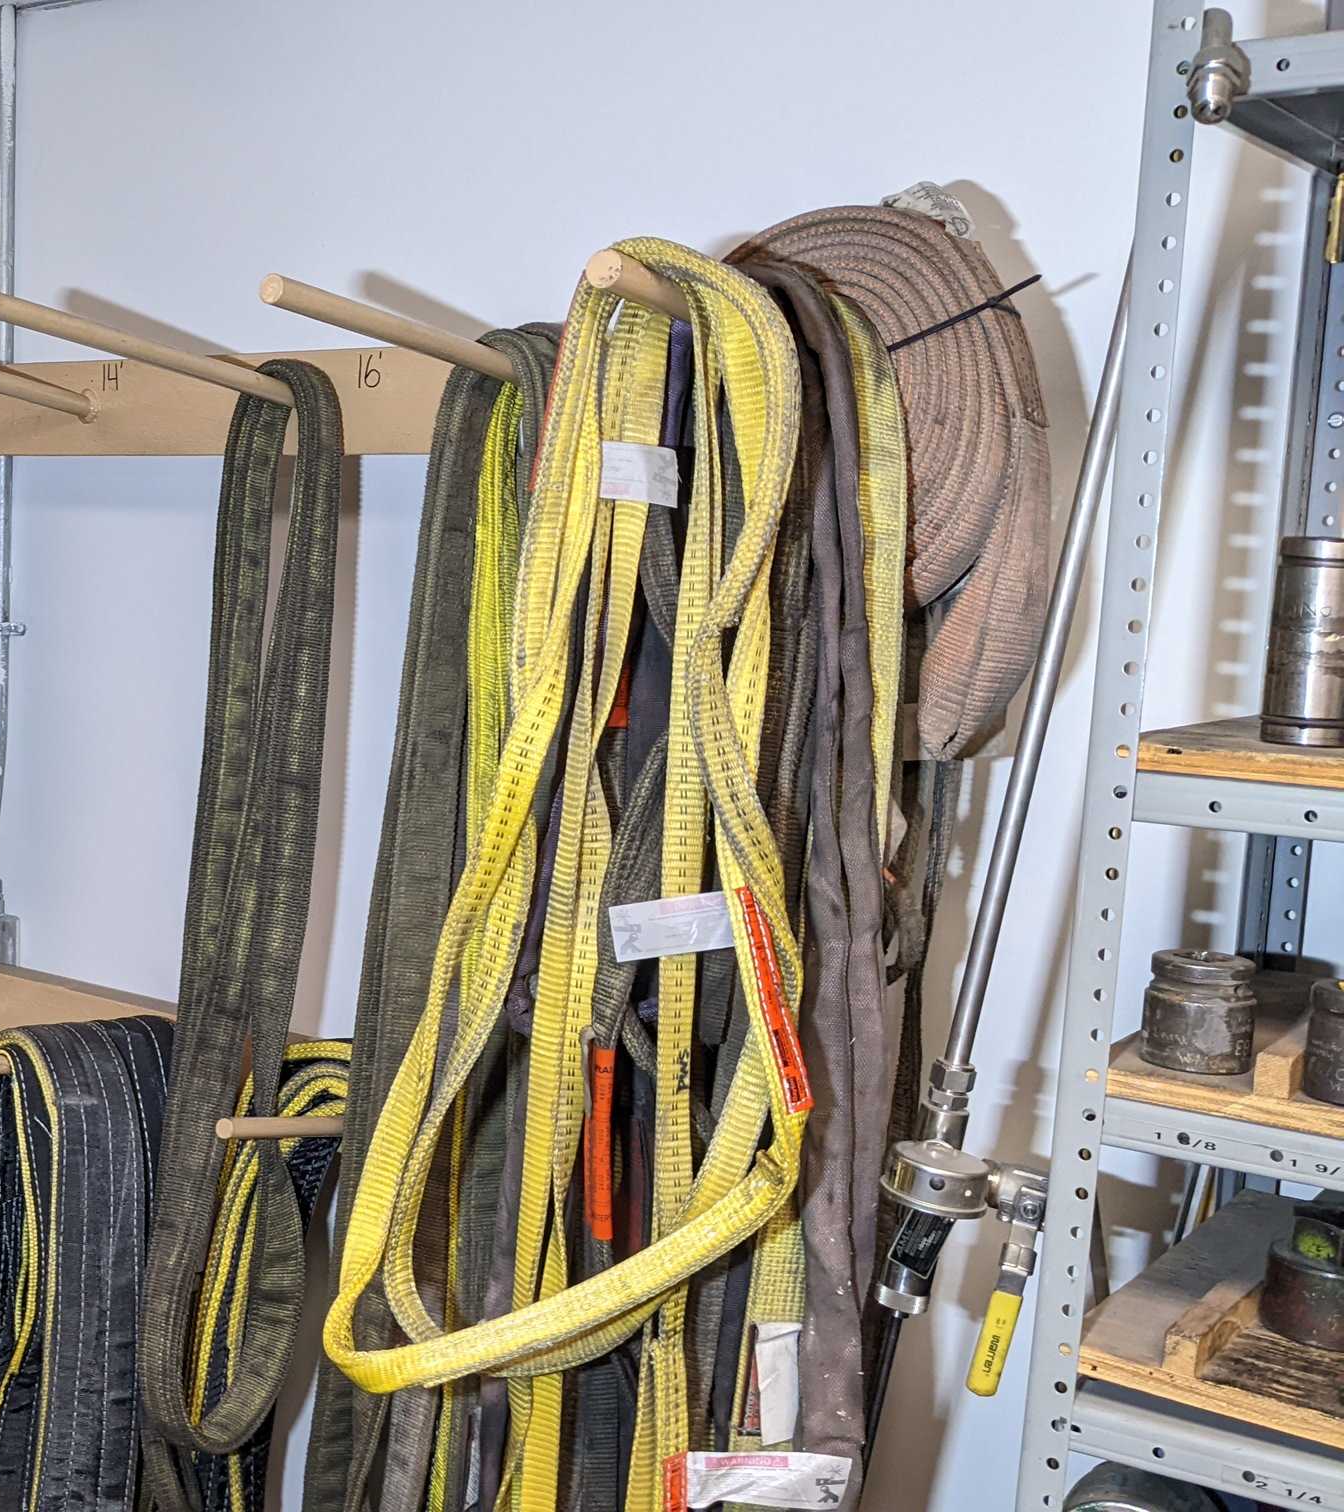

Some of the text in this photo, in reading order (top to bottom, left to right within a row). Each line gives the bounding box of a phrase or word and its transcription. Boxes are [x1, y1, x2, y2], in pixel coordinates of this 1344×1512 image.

[1154, 1132, 1161, 1140] 1
[1289, 1159, 1297, 1168] 1
[981, 1334, 1001, 1374] warren
[1255, 1480, 1323, 1504] 2 1/4
